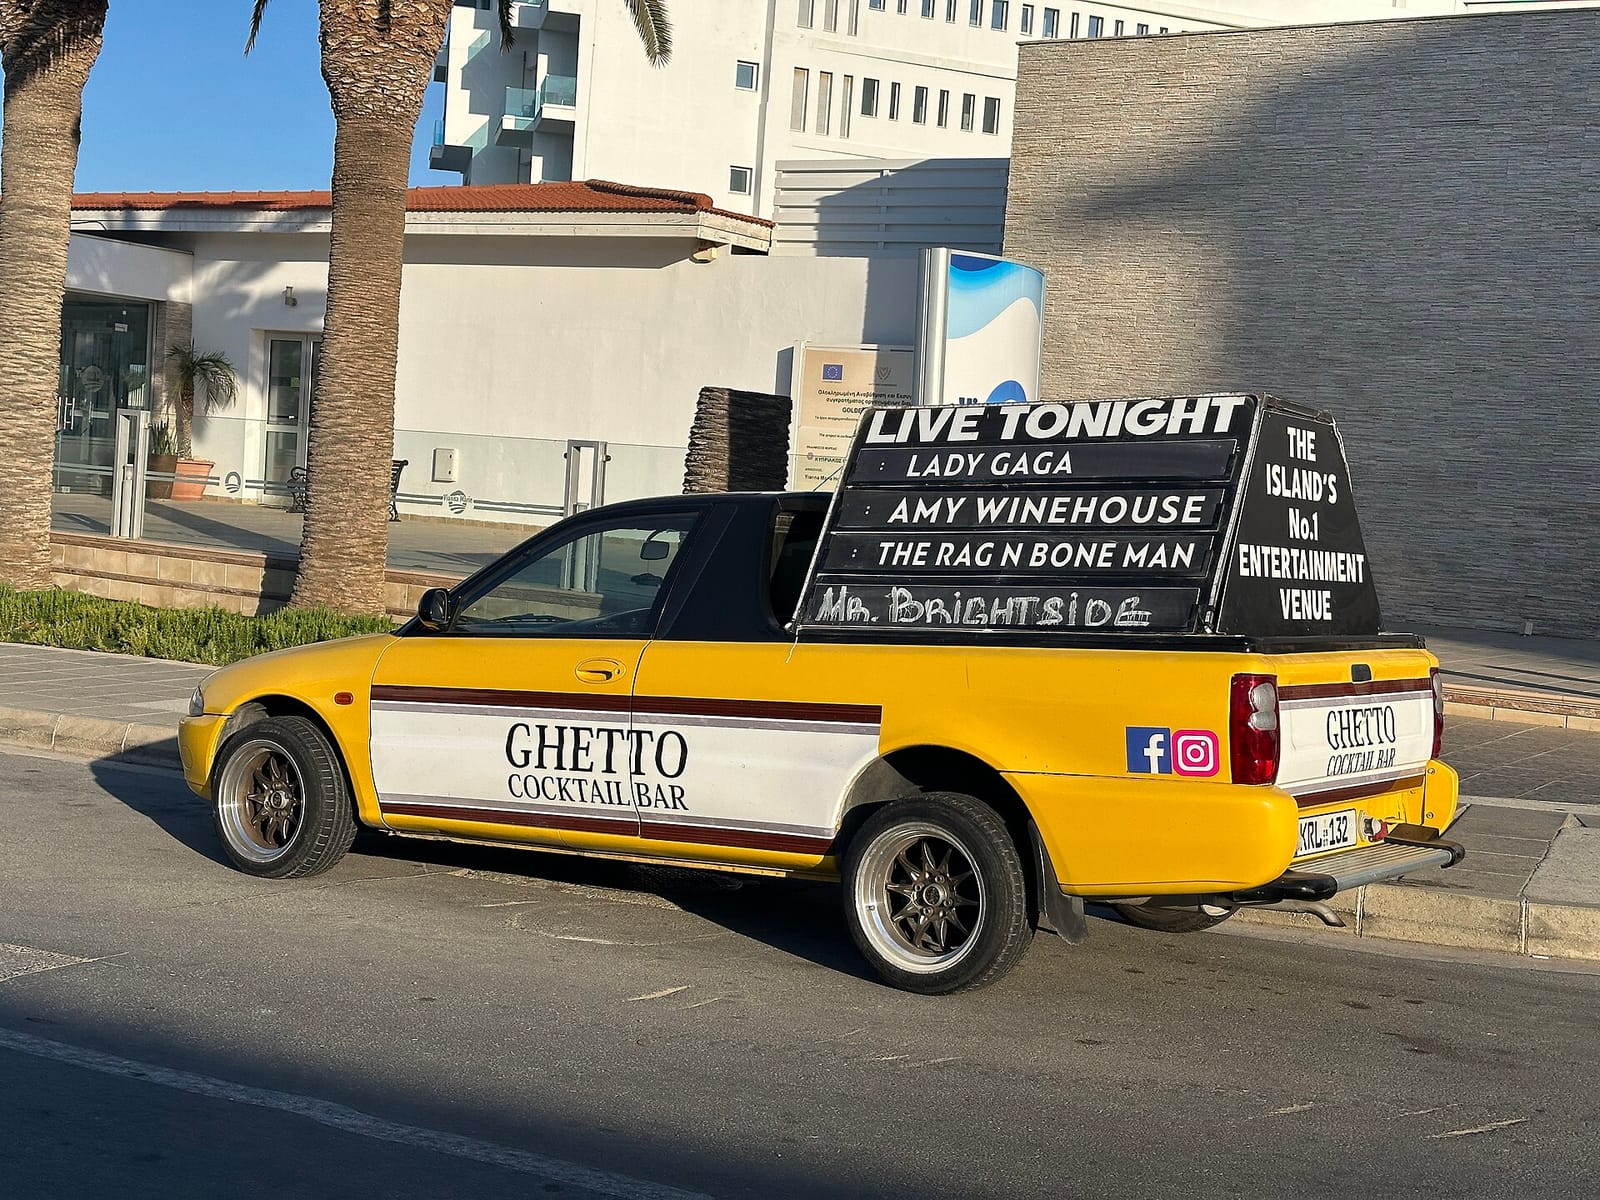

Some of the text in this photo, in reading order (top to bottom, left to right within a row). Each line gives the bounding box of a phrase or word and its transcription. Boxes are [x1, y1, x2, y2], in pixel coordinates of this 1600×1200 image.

[842, 406, 865, 414] GOLDE
[866, 396, 1246, 443] LIVE TONIGHT
[1287, 426, 1317, 462] THE
[907, 450, 1074, 478] LADY GAGA
[1265, 463, 1338, 504] ISLAND'S
[887, 494, 1206, 525] AMY WINEHOUSE
[1288, 507, 1319, 541] No.1
[878, 541, 1196, 569] THE RAG N BONE MAN
[1238, 544, 1365, 583] ENTERTAINMENT
[1279, 588, 1333, 621] VENUE
[1326, 705, 1396, 750] GHETTO
[505, 722, 689, 779] GHETTO
[1326, 747, 1396, 777] COCKTAIL BAR
[507, 773, 689, 810] COCKTAIL BAR
[1328, 815, 1349, 846] 132
